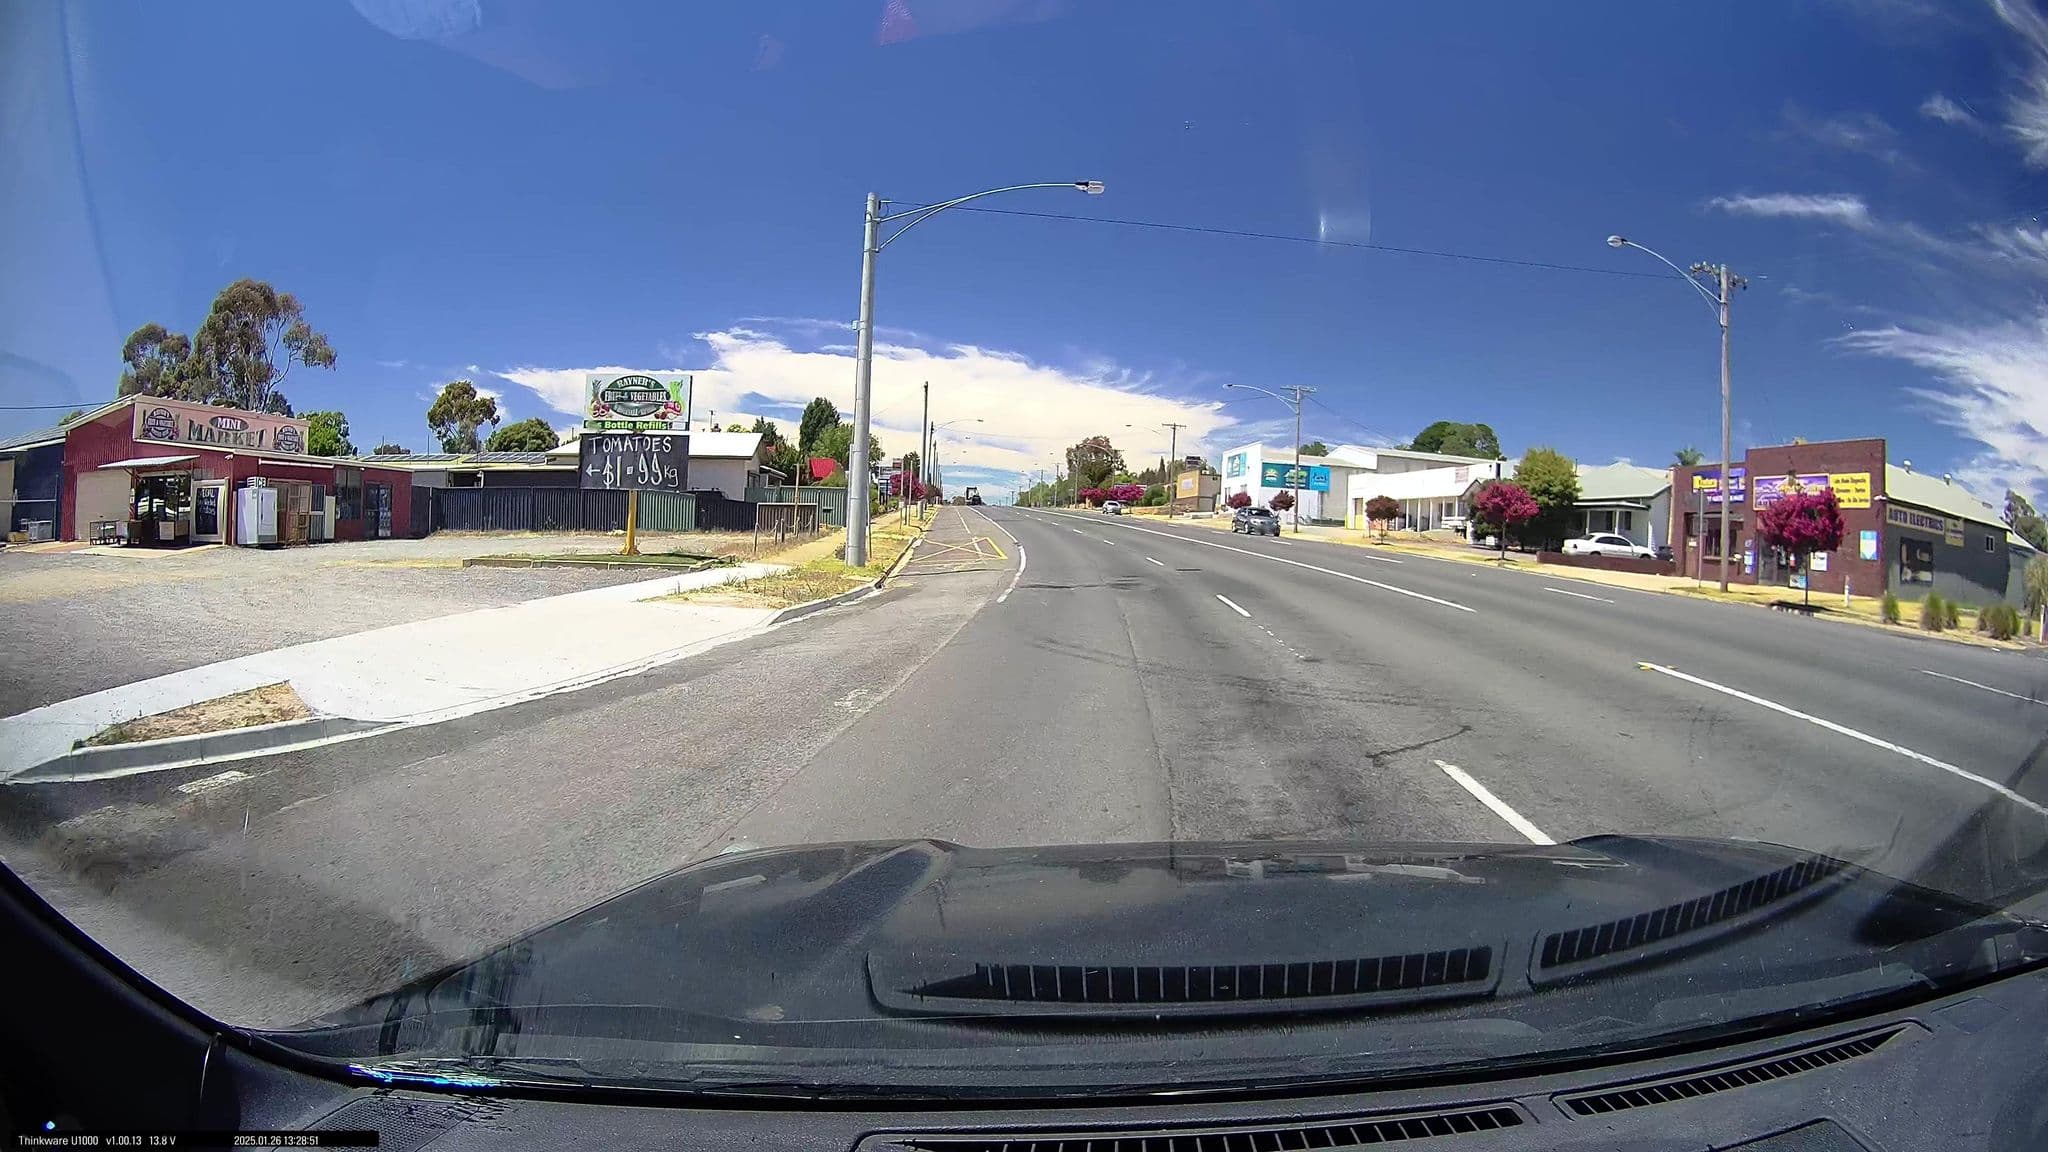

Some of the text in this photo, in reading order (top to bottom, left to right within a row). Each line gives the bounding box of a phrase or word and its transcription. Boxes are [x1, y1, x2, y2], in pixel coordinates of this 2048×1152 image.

[616, 376, 656, 389] RAYNER'S
[630, 390, 667, 402] VEGETABLES
[216, 416, 242, 431] MINI
[604, 421, 634, 430] Bottle
[636, 421, 667, 430] Refills
[188, 418, 268, 448] MARKET
[589, 436, 672, 454] TOMATOES
[1889, 507, 1944, 532] AUTO ELECTRICS
